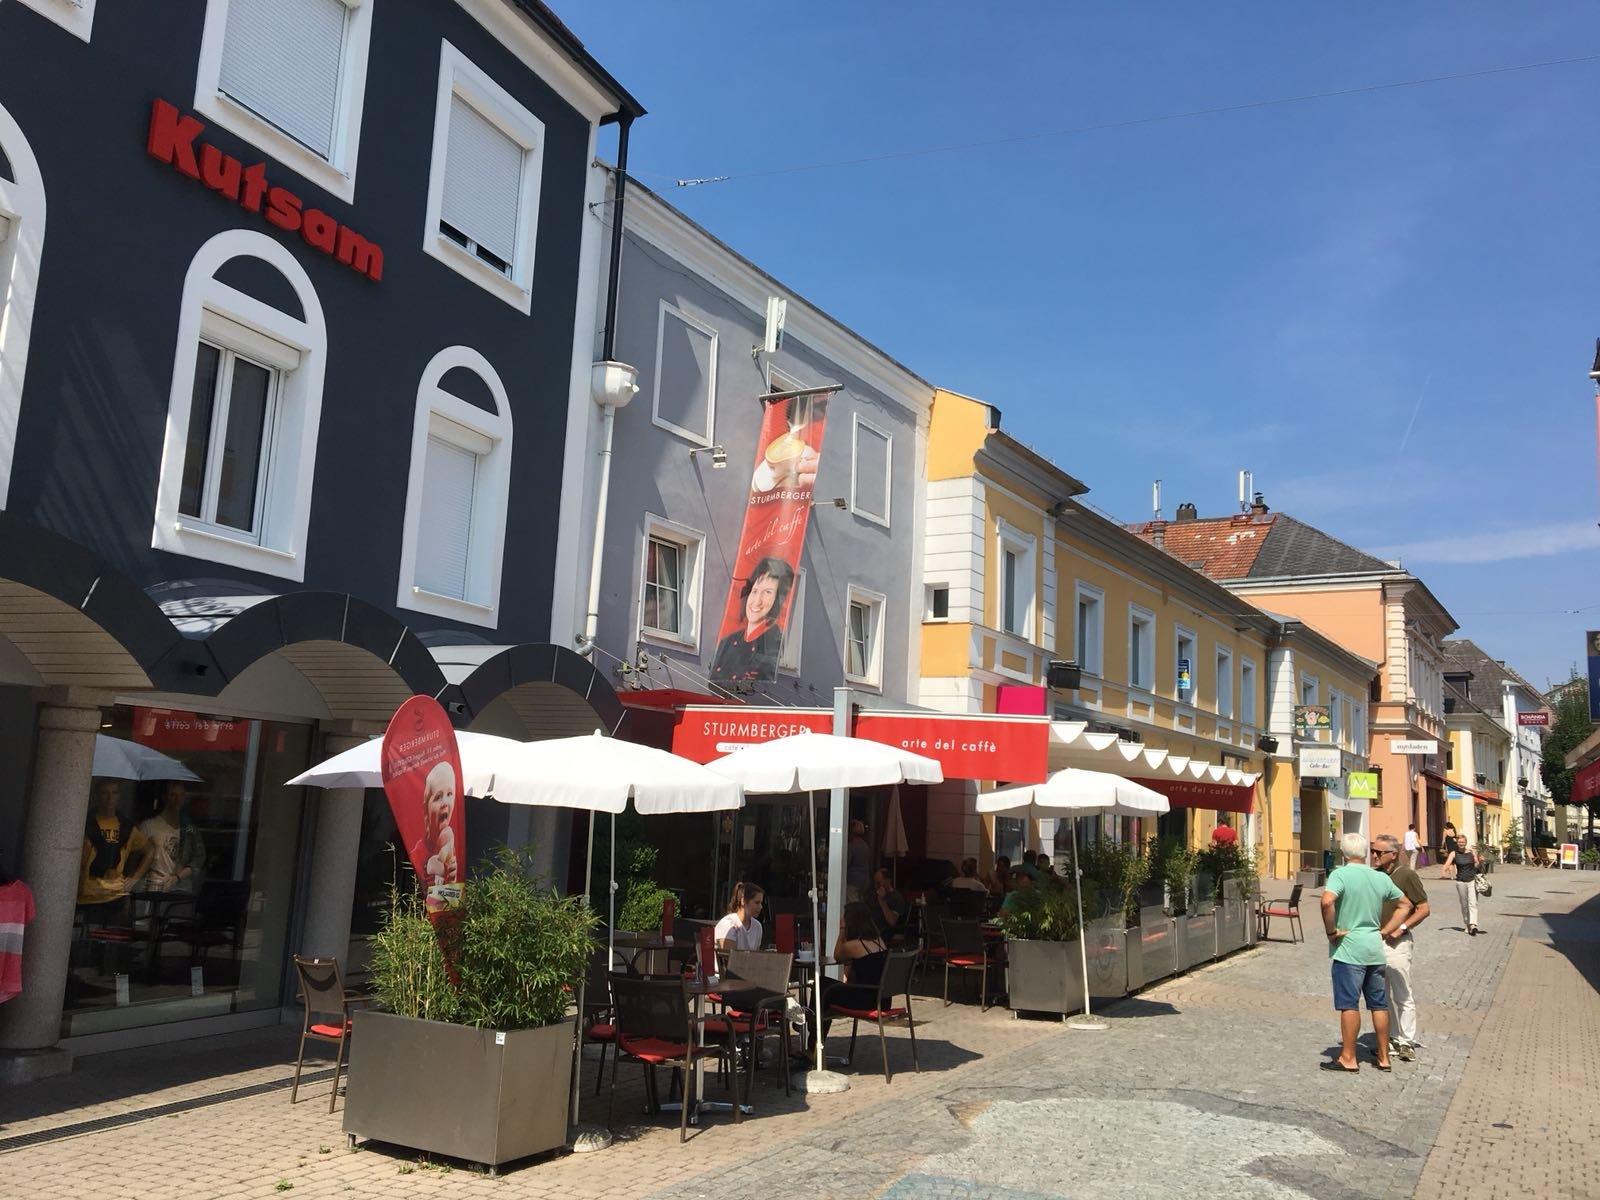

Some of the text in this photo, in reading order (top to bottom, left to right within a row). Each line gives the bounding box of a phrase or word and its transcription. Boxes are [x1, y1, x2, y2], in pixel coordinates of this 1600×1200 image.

[148, 98, 384, 282] Kutsam
[750, 491, 811, 505] STURMBERGER
[902, 738, 996, 753] arte del caffè
[1192, 784, 1206, 794] del
